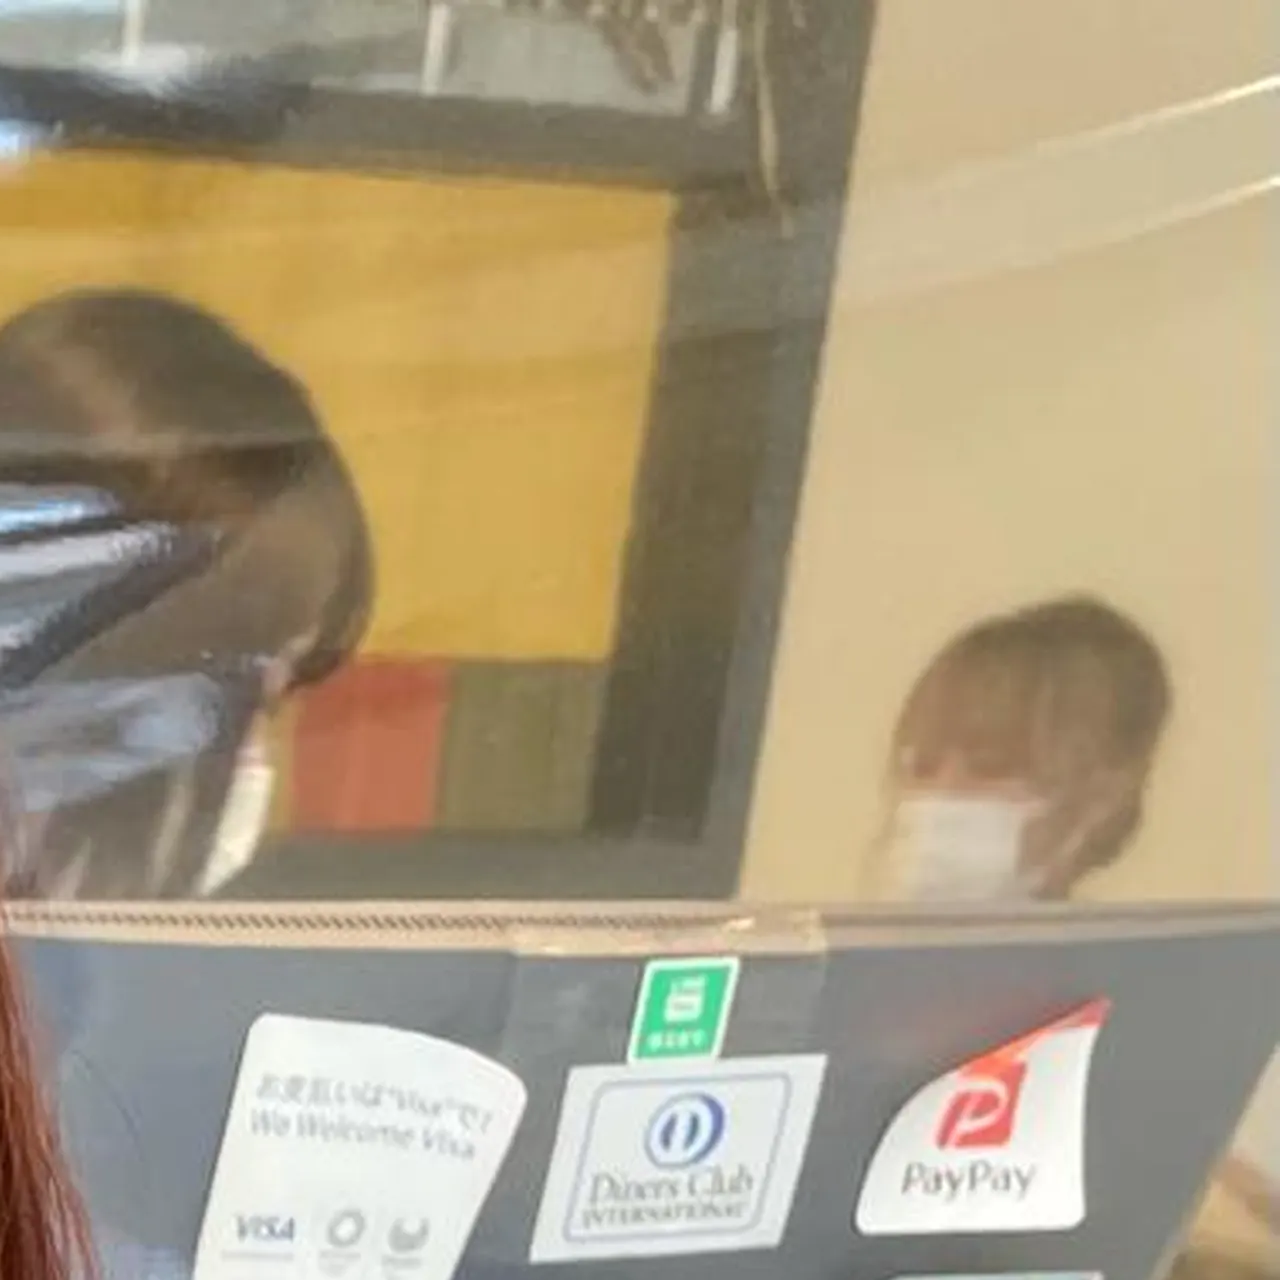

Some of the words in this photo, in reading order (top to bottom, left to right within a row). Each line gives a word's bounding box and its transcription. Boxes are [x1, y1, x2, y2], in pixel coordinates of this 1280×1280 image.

[251, 1109, 290, 1137] We
[297, 1112, 415, 1150] Welcome
[421, 1126, 476, 1162] Visa
[592, 1171, 679, 1206] Diners
[688, 1162, 754, 1196] Club
[901, 1160, 1035, 1201] PayPay
[236, 1215, 295, 1243] VISA
